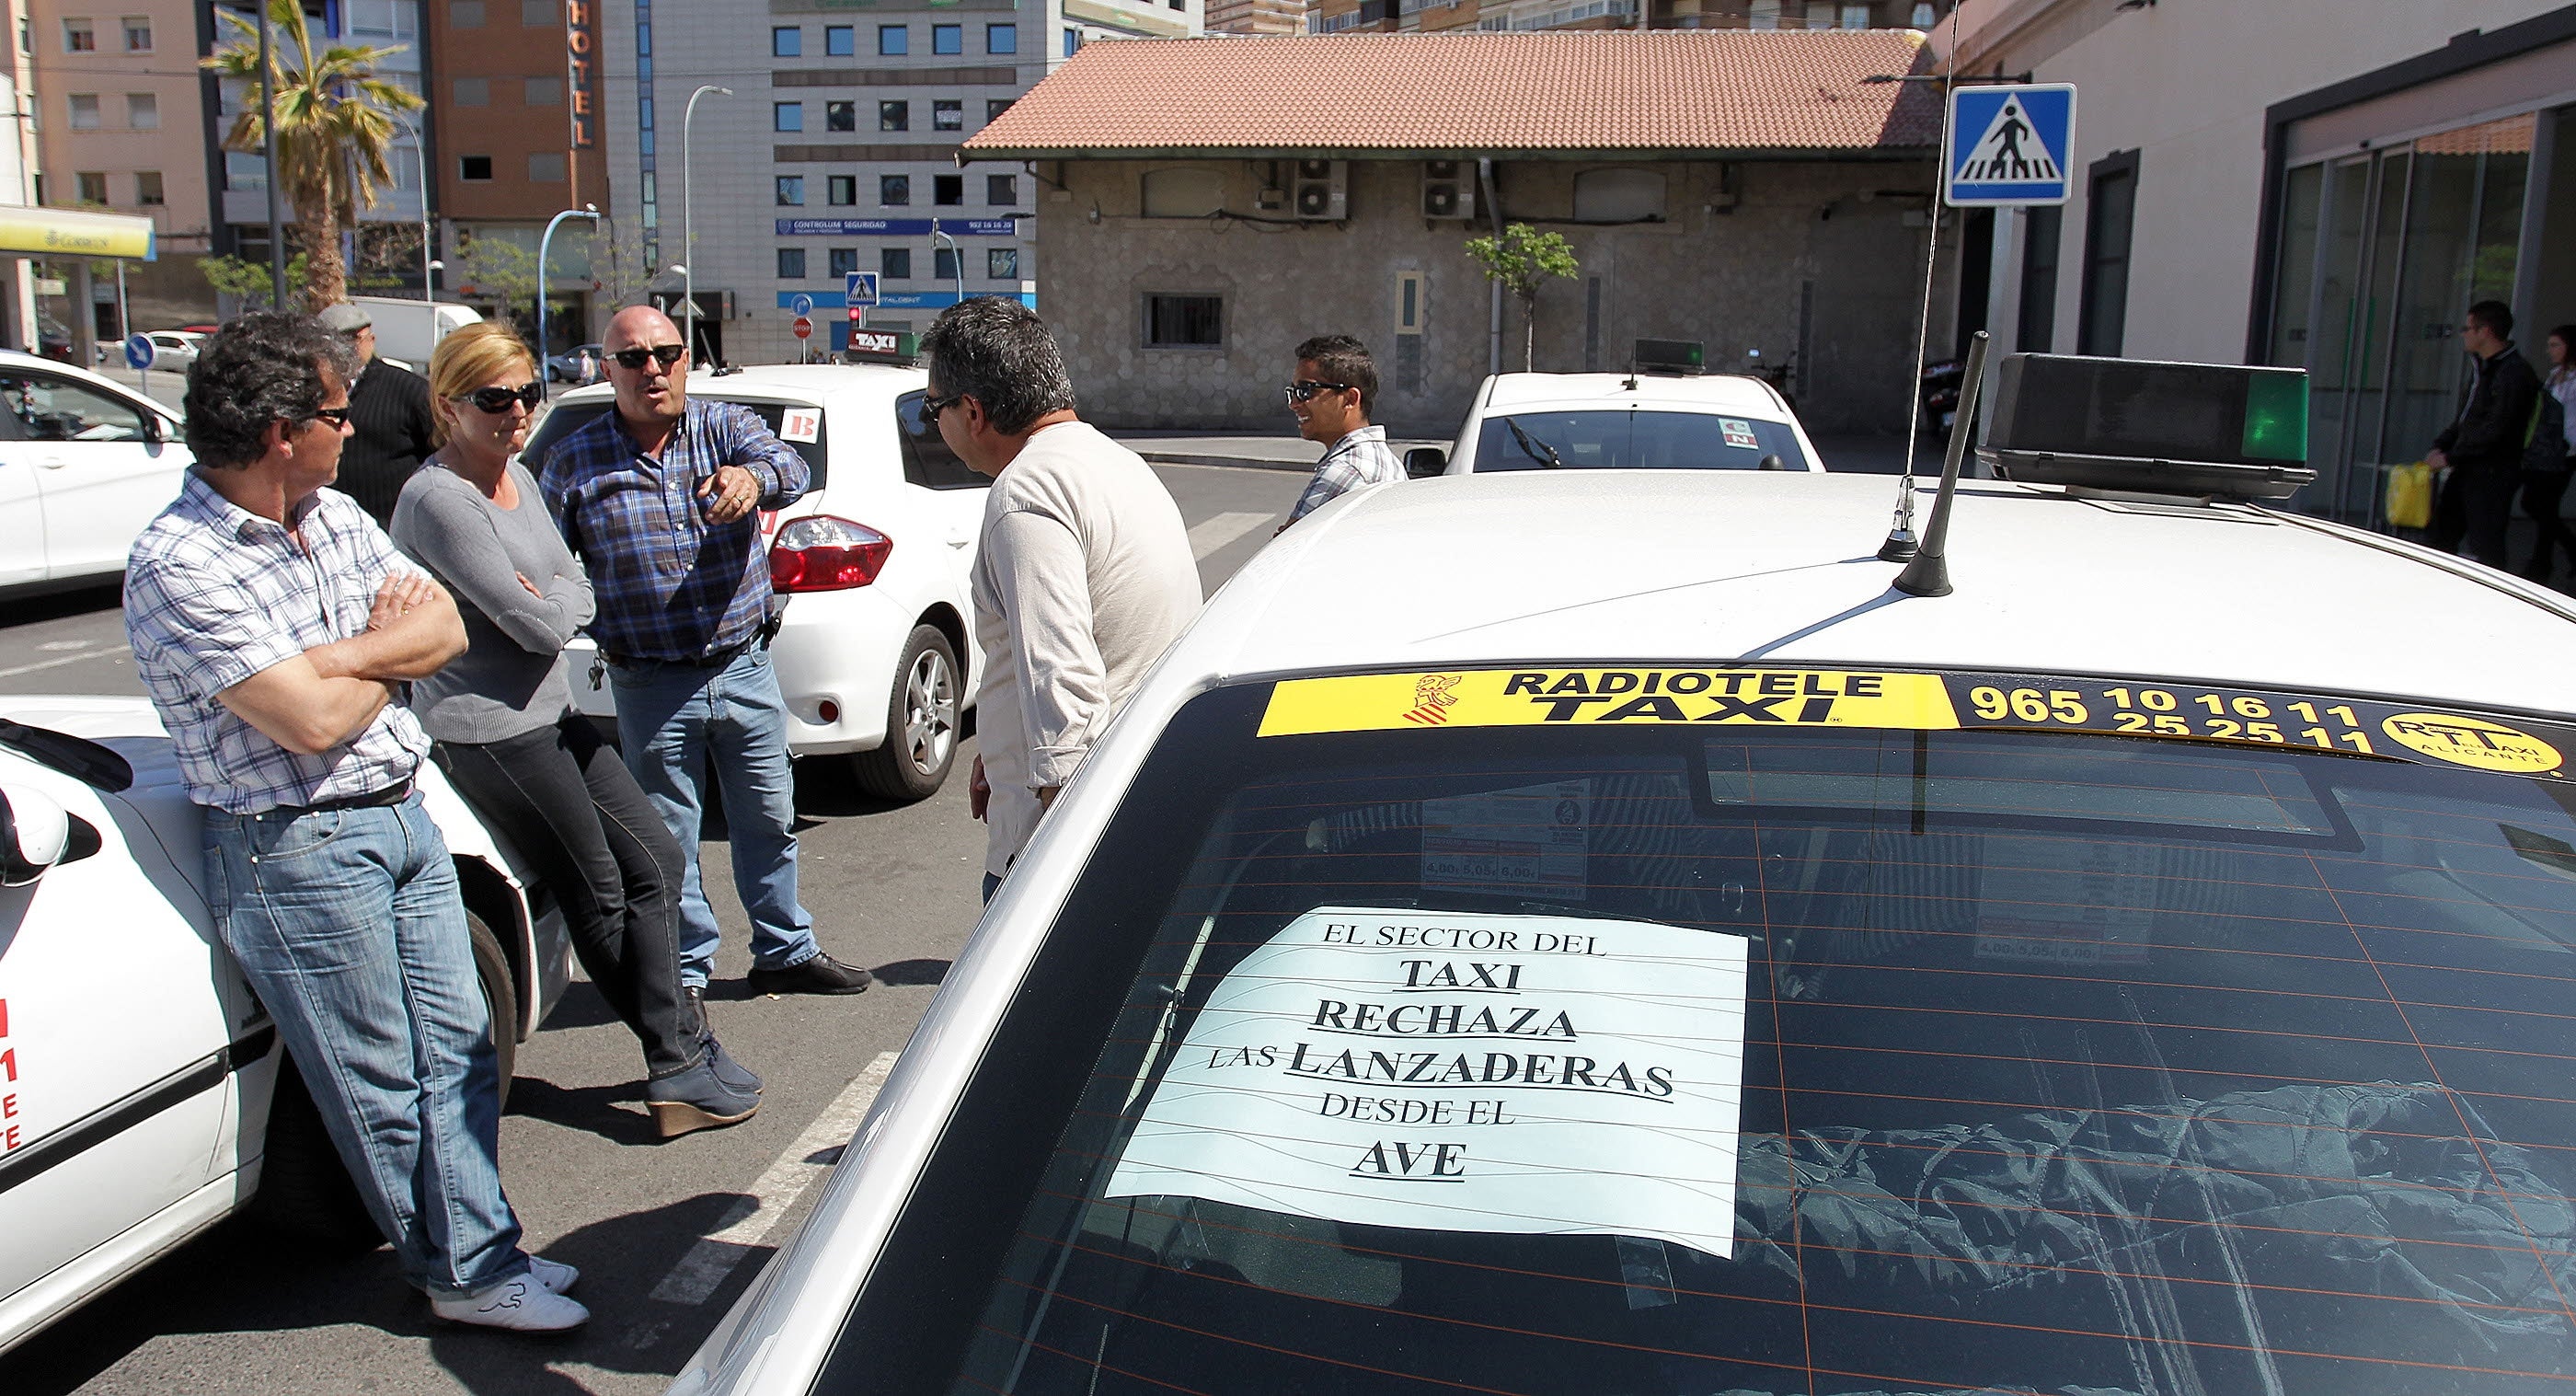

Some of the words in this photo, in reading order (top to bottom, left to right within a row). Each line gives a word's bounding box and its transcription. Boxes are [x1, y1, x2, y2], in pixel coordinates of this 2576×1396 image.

[569, 0, 592, 145] HOTEL
[844, 221, 886, 229] SEGURIDAD
[855, 333, 896, 351] TAXI
[790, 415, 814, 435] B
[1503, 673, 1882, 698] RADIOTELE
[1531, 695, 1836, 723] TAXI
[1970, 686, 2088, 724] 965
[2103, 688, 2178, 711] 10
[2195, 694, 2271, 718] 16
[2287, 701, 2360, 727] 11
[2112, 712, 2191, 735] 25
[2205, 719, 2284, 744] 25
[2301, 727, 2375, 754] 11
[2421, 744, 2548, 765] ALICANTE
[1322, 924, 1369, 946] EL
[1375, 926, 1520, 951] SECTOR
[1534, 932, 1608, 957] DEL
[1398, 960, 1523, 991] TAXI
[1309, 998, 1578, 1038] RECHAZA
[1207, 1045, 1279, 1069] LAS
[1284, 1043, 1674, 1099] LANZADERAS
[1319, 1092, 1454, 1125] DESDE
[1466, 1100, 1517, 1125] EL
[1351, 1141, 1467, 1178] AVE
